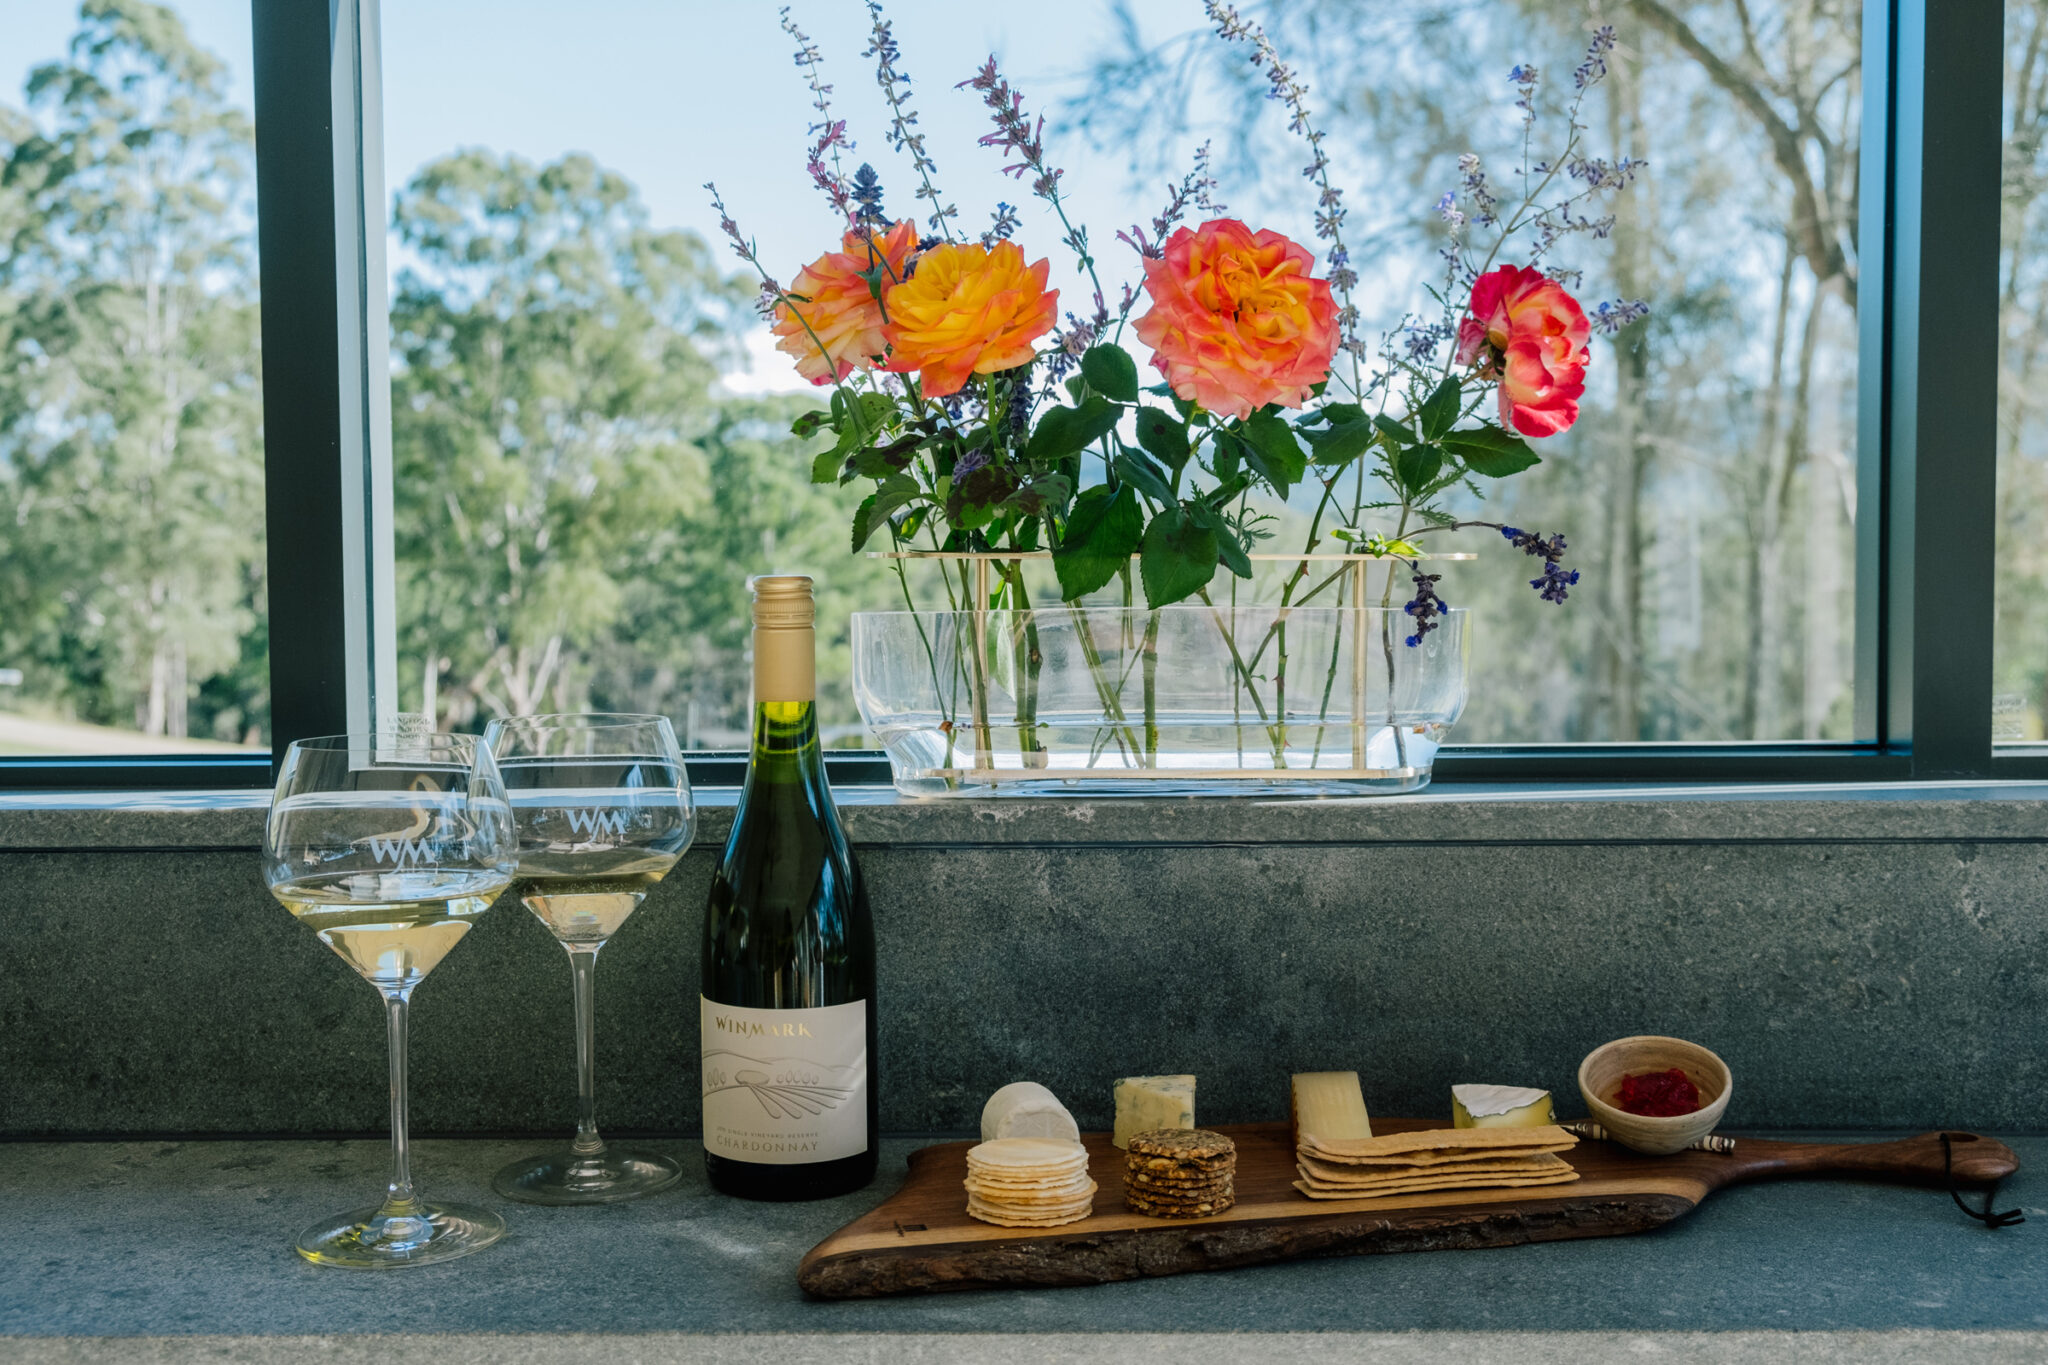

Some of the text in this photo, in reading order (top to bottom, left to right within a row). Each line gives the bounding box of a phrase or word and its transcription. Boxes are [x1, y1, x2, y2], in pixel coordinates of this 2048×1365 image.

[564, 805, 628, 845] WM
[369, 826, 437, 875] WM
[715, 1014, 814, 1039] WINMARK
[716, 1134, 819, 1153] CHARDONNAY
